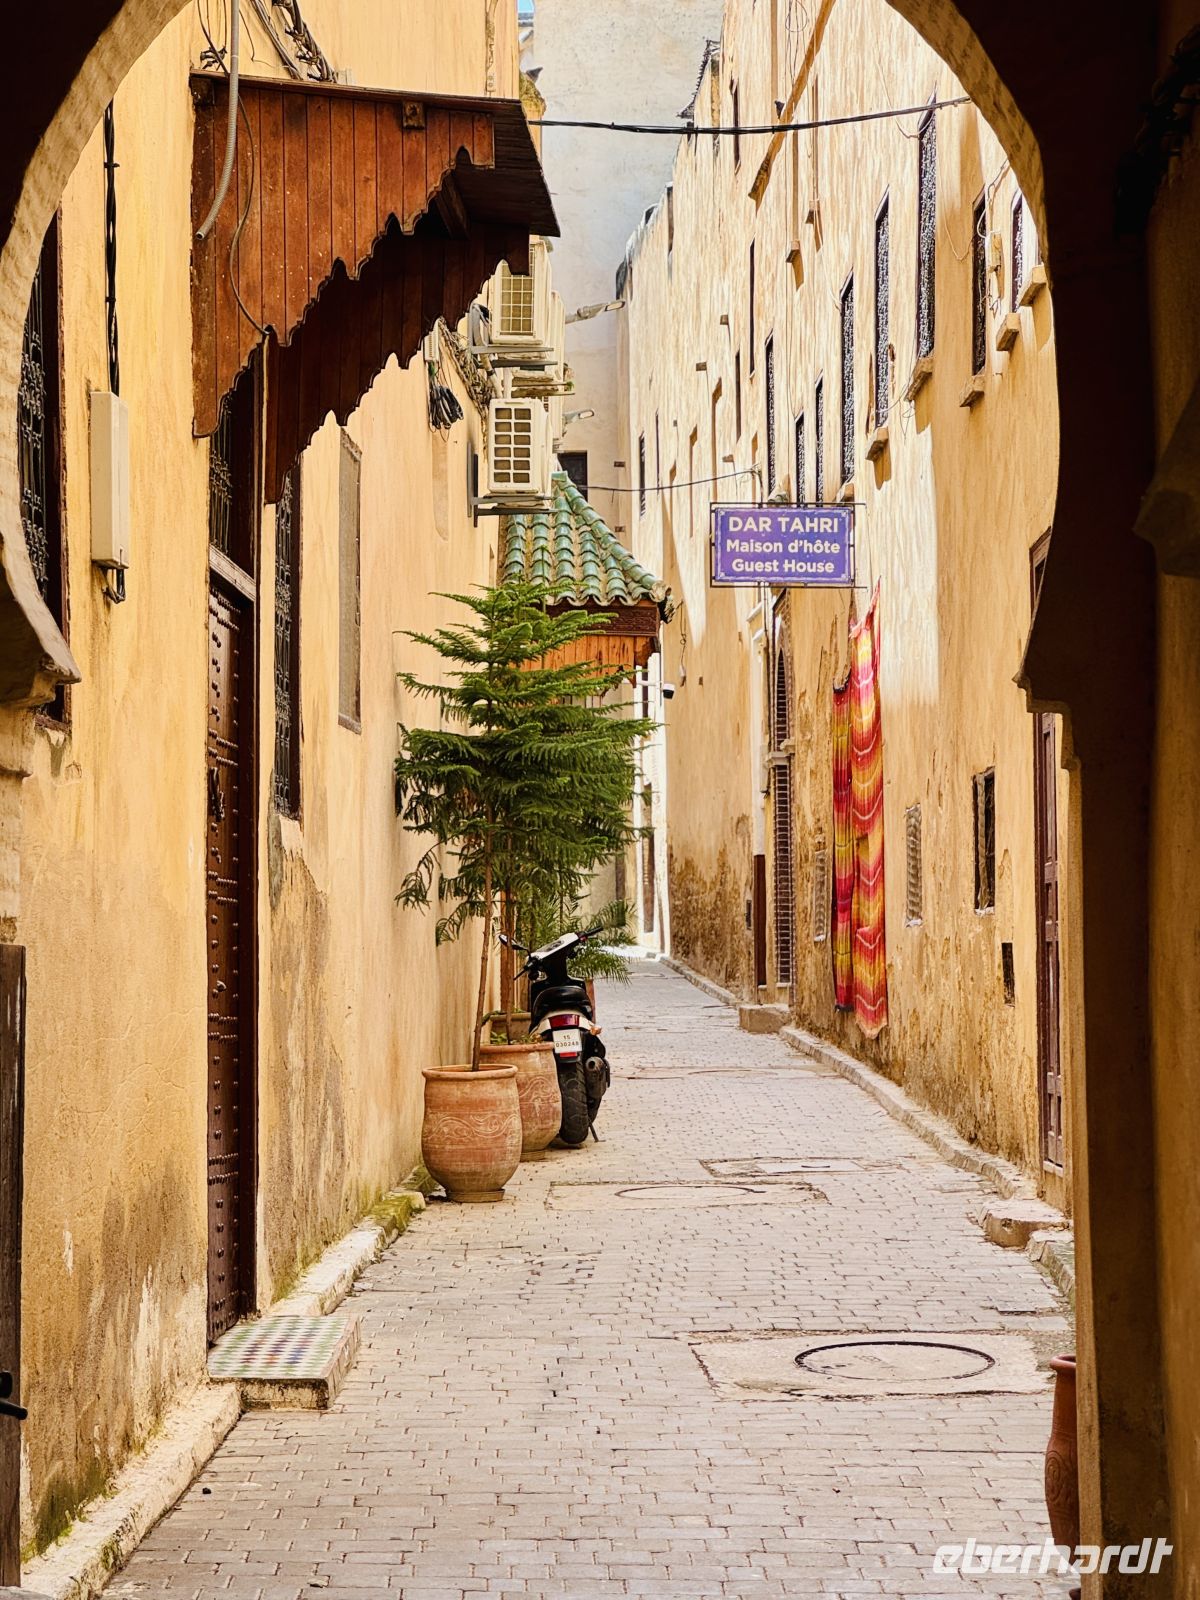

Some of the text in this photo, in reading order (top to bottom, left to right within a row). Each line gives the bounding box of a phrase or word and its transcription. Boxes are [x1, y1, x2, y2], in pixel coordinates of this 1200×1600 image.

[728, 516, 839, 533] DAR TAHRI
[726, 539, 841, 554] Maison d’hôte
[731, 558, 835, 573] Guest House
